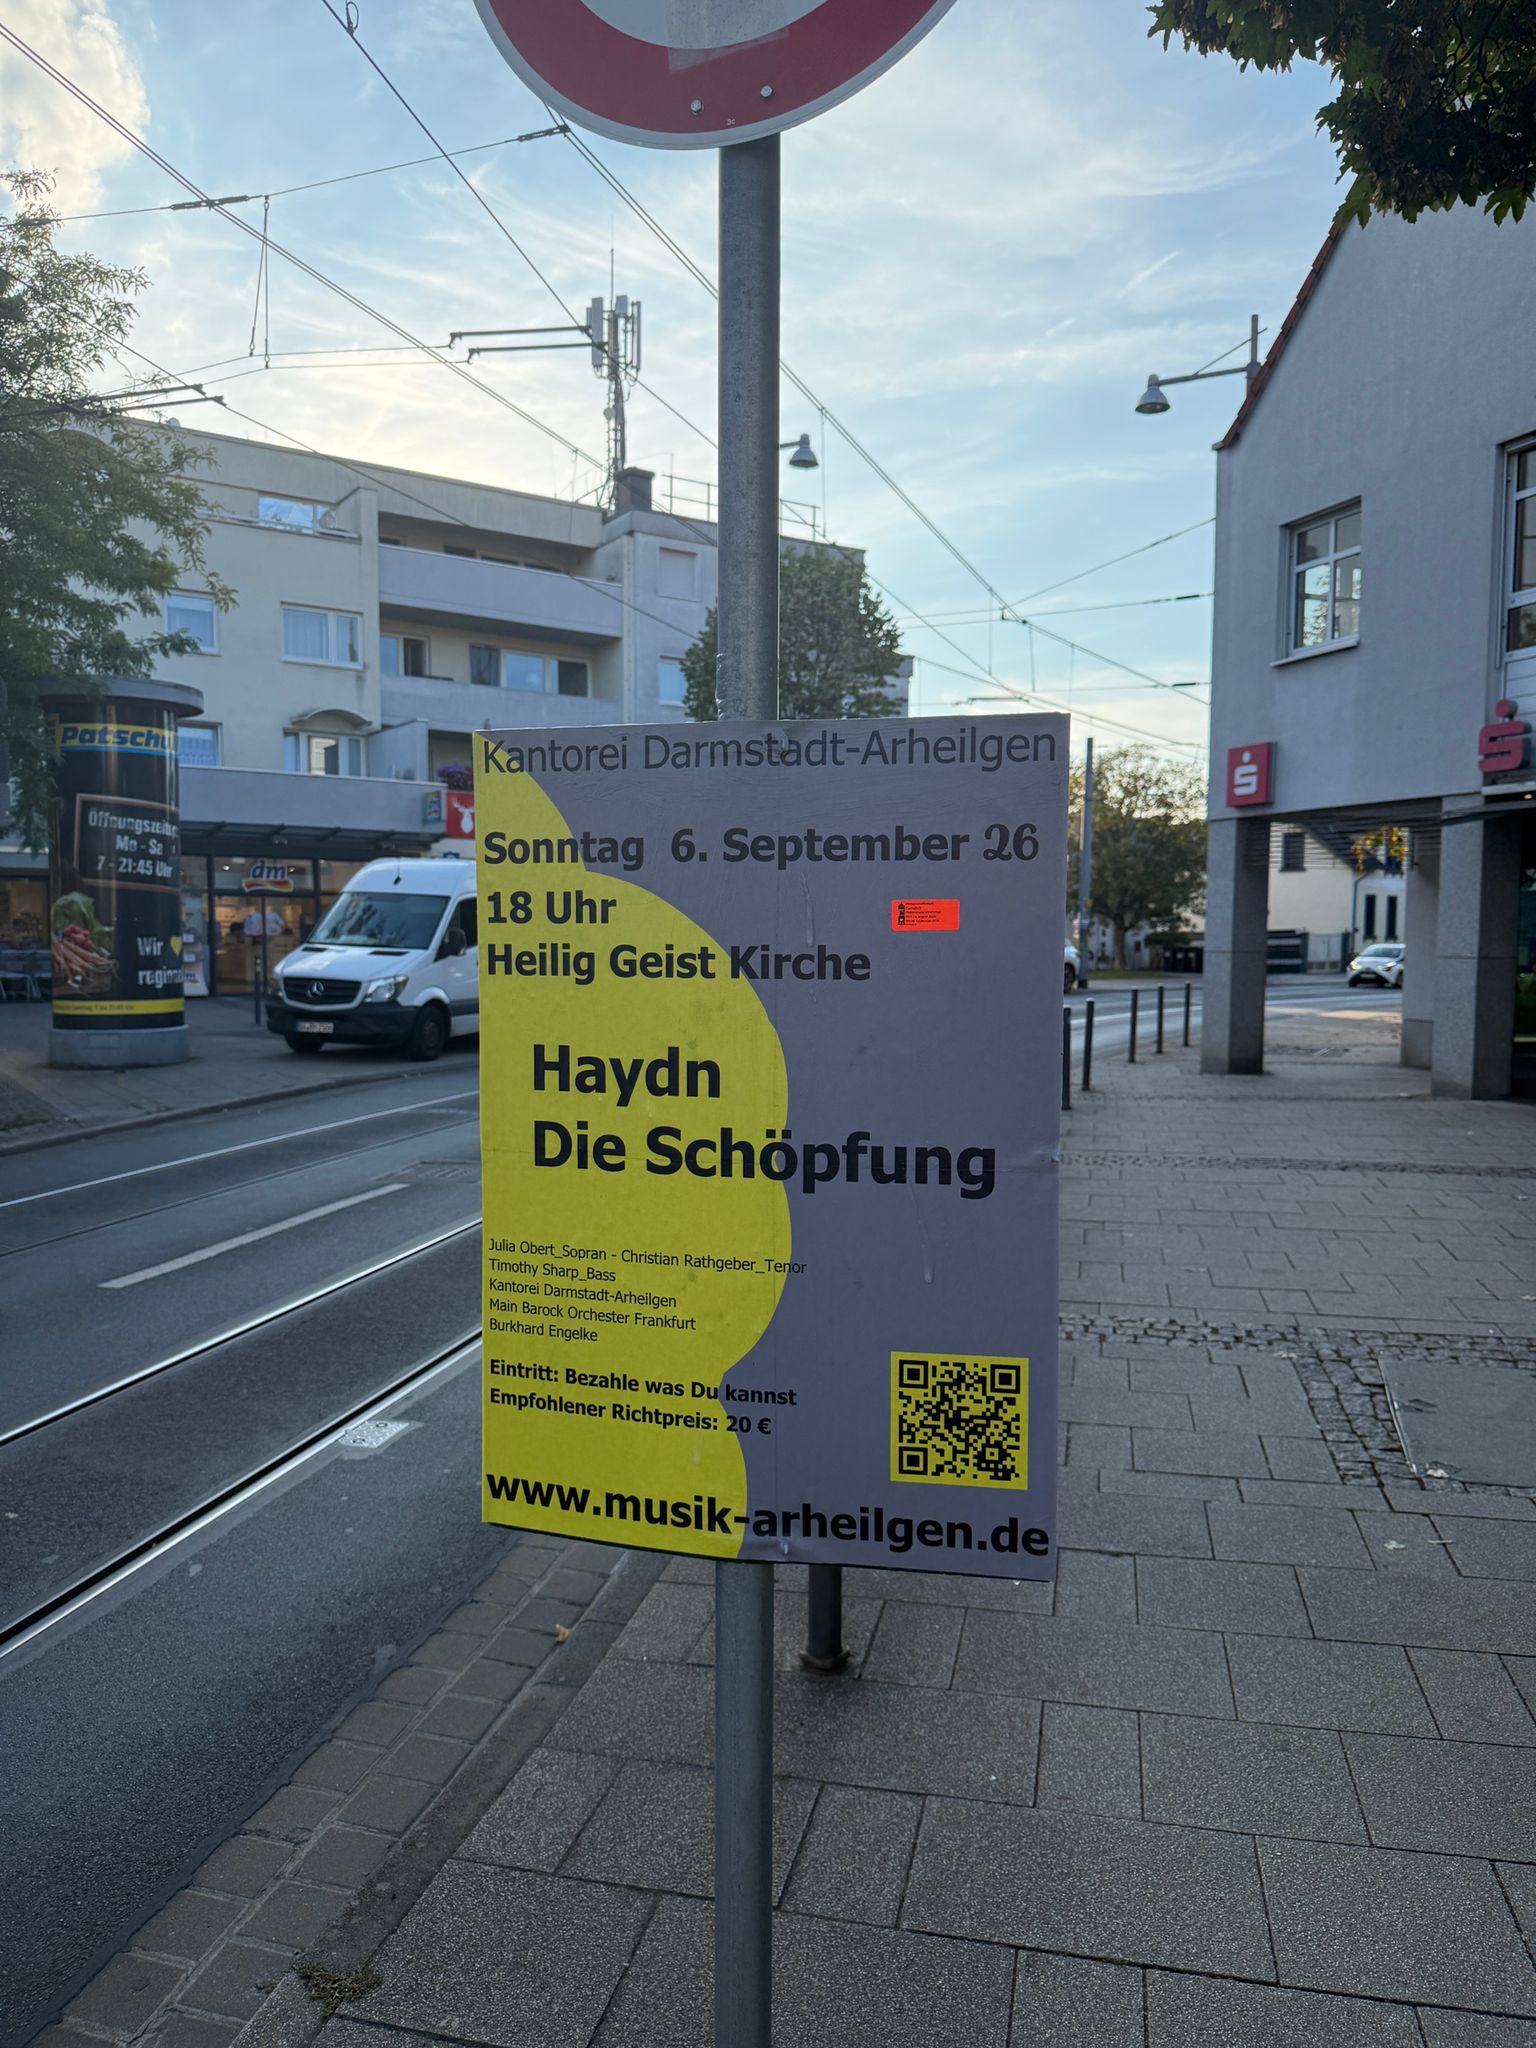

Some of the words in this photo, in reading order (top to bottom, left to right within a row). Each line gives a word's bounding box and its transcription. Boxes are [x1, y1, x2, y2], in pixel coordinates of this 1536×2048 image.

[484, 737, 628, 774] Kantorei
[645, 726, 1055, 772] Darmstadt-Arheilgen
[116, 834, 138, 852] Mo
[484, 831, 643, 872] Sonntag
[671, 828, 708, 862] 6.
[723, 826, 969, 870] September
[983, 823, 1039, 861] 26
[97, 856, 107, 871] 7
[118, 857, 153, 876] 21:45
[156, 860, 174, 878] Uhr
[252, 859, 286, 879] dm
[487, 891, 532, 924] 18
[546, 890, 616, 925] Uhr
[137, 936, 164, 956] Wir
[487, 943, 595, 985] Heilig
[609, 944, 716, 979] Geist
[730, 945, 871, 981] Kirche
[533, 1044, 721, 1107] Haydn
[533, 1120, 626, 1173] Die
[646, 1126, 996, 1199] Schöpfung
[489, 1238, 516, 1253] Julia
[520, 1241, 607, 1261] Obert_Sopran
[621, 1249, 679, 1266] Christian
[684, 1254, 807, 1274] Rathgeber_Tenor
[489, 1258, 539, 1277] Timothy
[542, 1263, 616, 1282] Sharp_Bass
[489, 1278, 540, 1295] Kantorei
[544, 1283, 677, 1309] Darmstadt-Arheilgen
[489, 1298, 518, 1313] Main
[522, 1301, 564, 1318] Barock
[567, 1306, 630, 1325] Orchester
[635, 1313, 696, 1331] Frankfurt
[489, 1318, 544, 1336] Burkhard
[548, 1324, 598, 1342] Engelke
[490, 1359, 559, 1383] Eintritt:
[565, 1368, 639, 1392] Bezahle
[645, 1379, 685, 1397] was
[691, 1381, 719, 1400] Du
[726, 1384, 797, 1406] kannst
[490, 1388, 606, 1418] Empfohlener
[612, 1404, 719, 1430] Richtpreis:
[726, 1415, 752, 1434] 20
[757, 1417, 772, 1435] €
[486, 1473, 1049, 1558] www.musik-arheilgen.de
